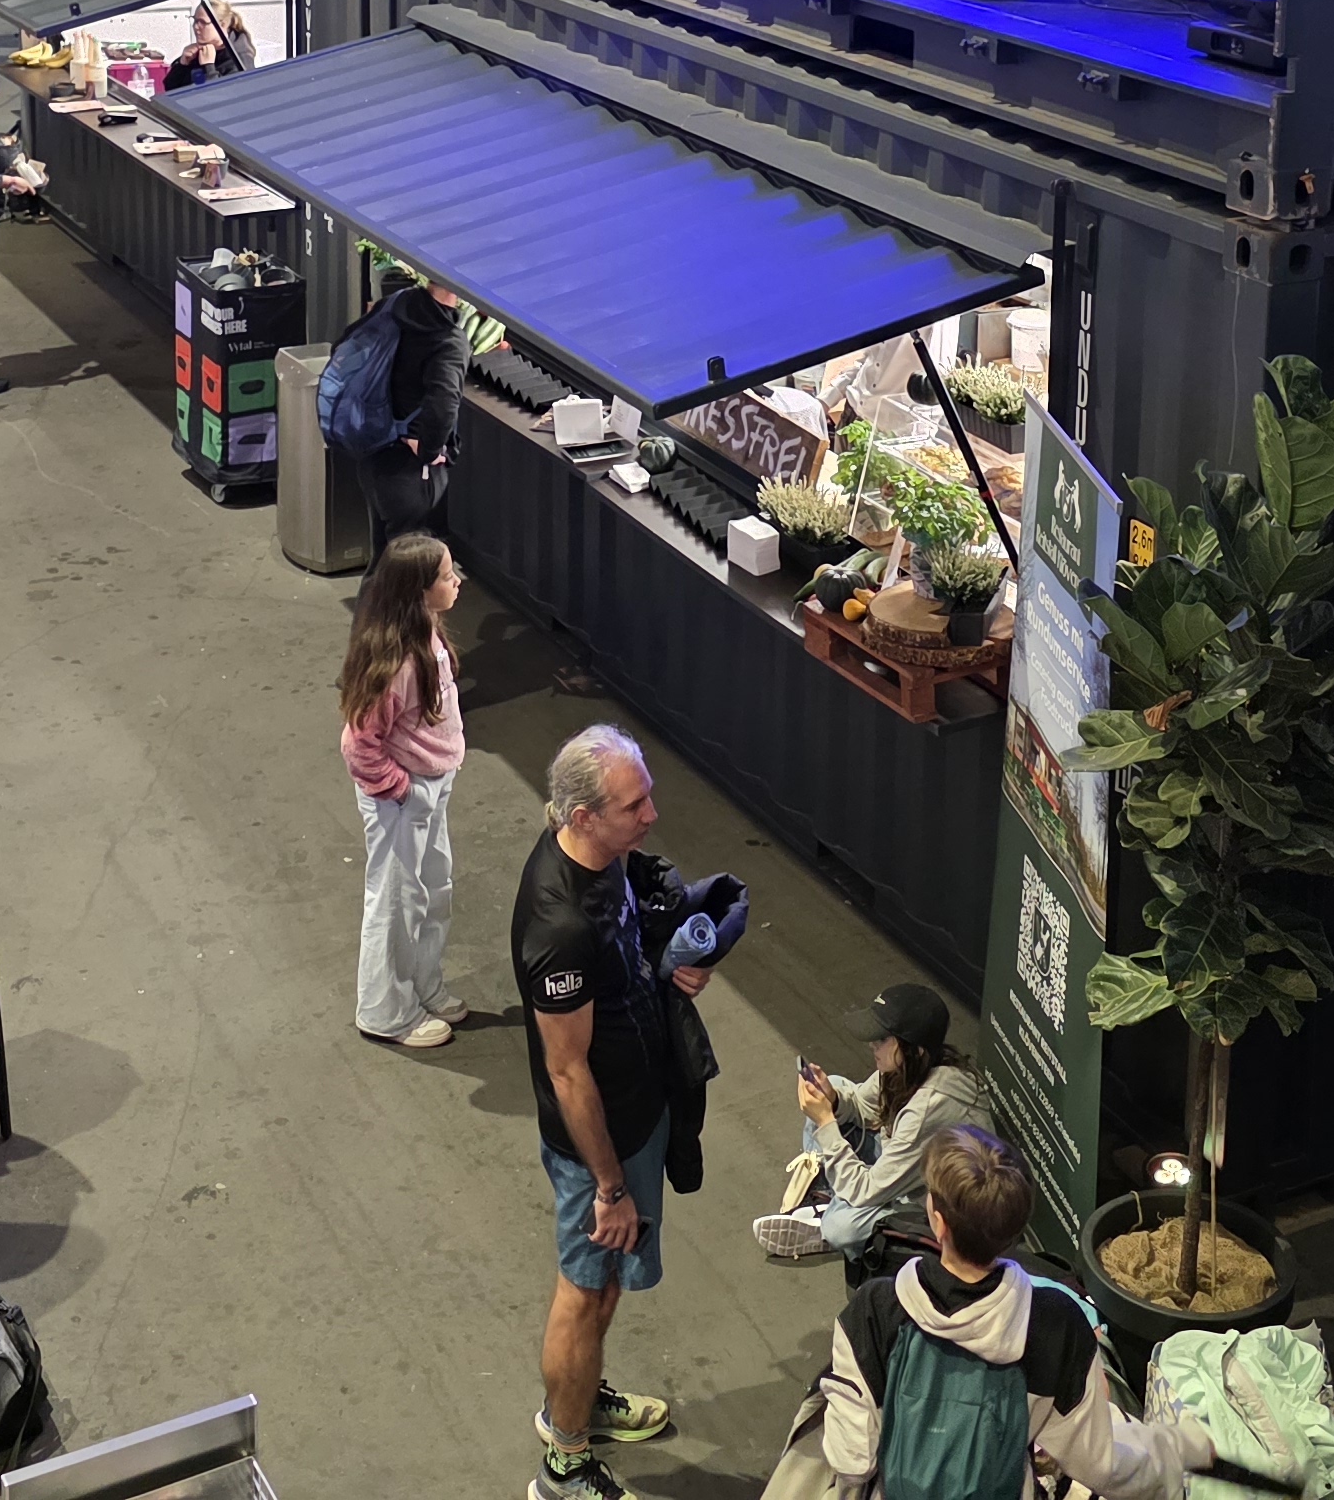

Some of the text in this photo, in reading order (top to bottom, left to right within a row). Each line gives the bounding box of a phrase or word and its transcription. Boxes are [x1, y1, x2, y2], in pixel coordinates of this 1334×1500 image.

[224, 319, 248, 335] HERE
[1074, 290, 1092, 446] UNDU
[1037, 581, 1070, 637] Genuss
[1026, 599, 1091, 704] Rundumservice
[545, 972, 583, 997] hella
